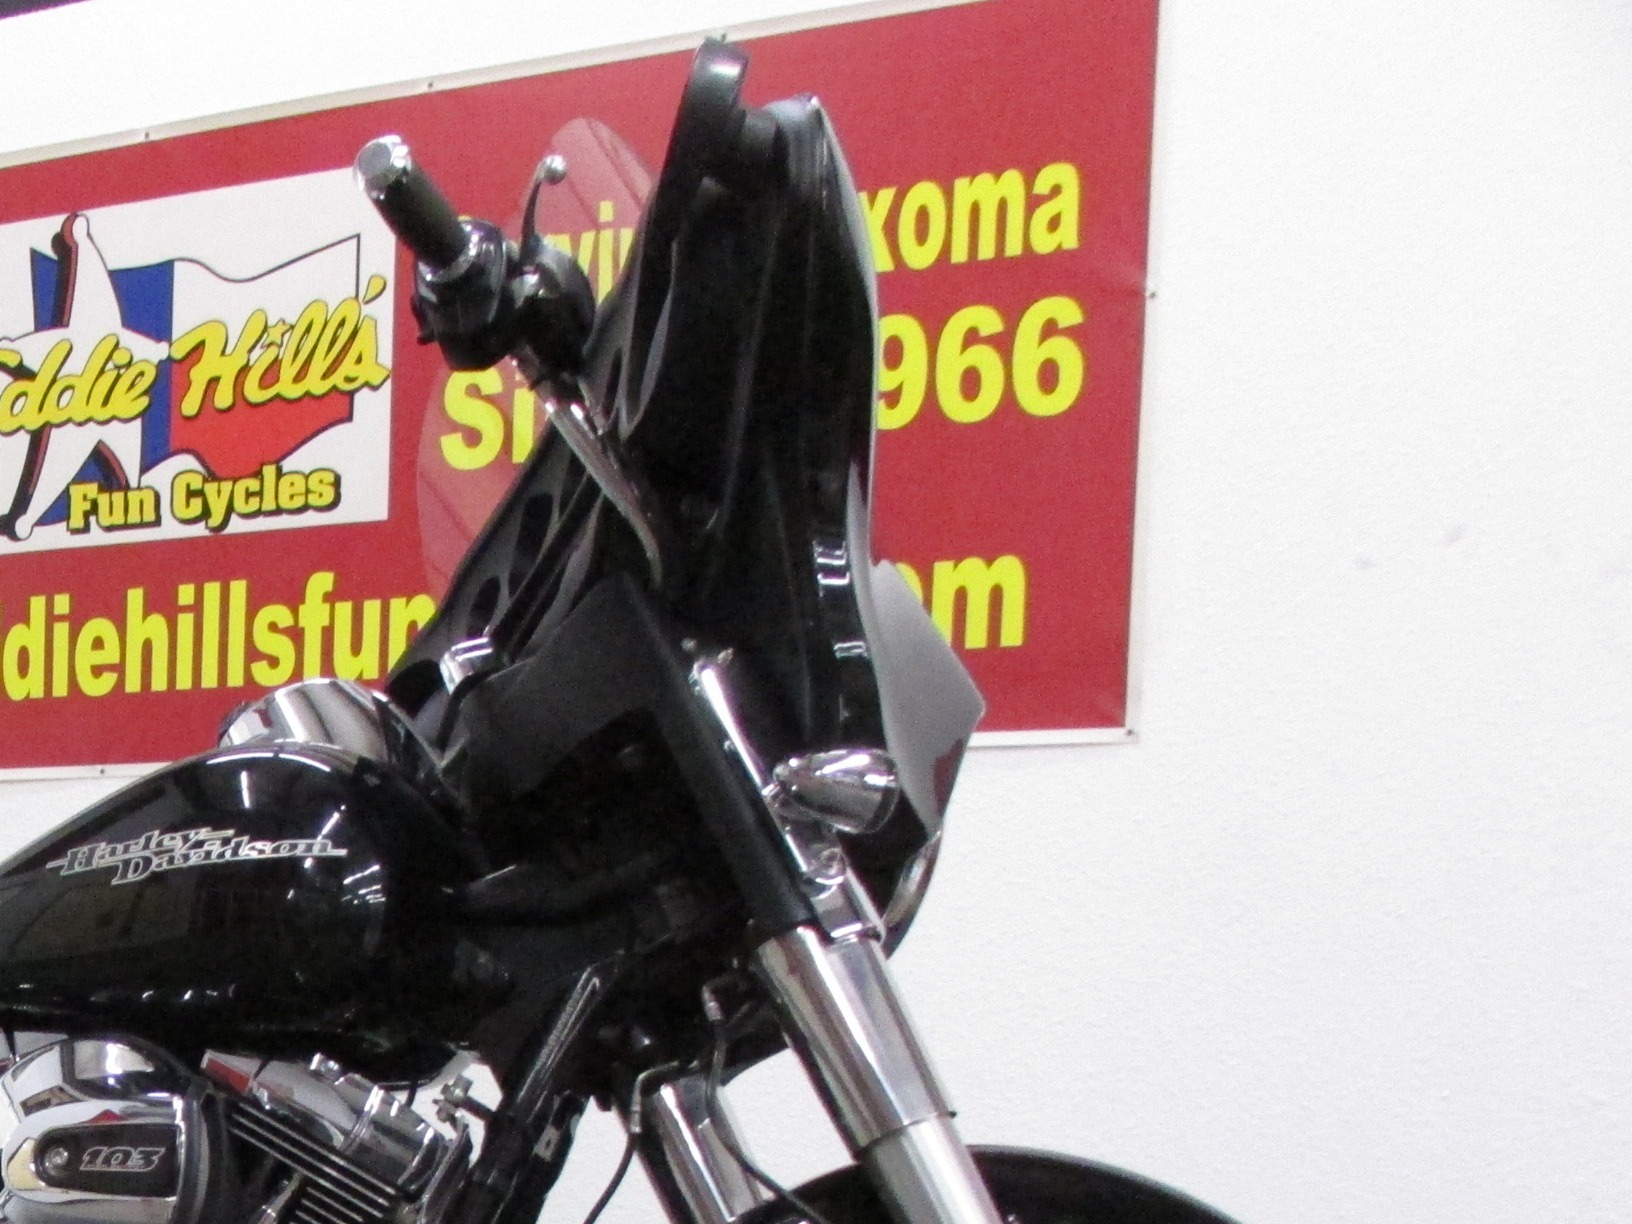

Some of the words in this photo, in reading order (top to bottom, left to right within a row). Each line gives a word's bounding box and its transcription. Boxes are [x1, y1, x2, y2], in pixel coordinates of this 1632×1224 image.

[857, 162, 1080, 273] xoma
[171, 275, 391, 418] Hill's
[874, 295, 1085, 431] 966
[67, 482, 161, 533] Fun
[171, 464, 342, 530] Cycles
[111, 835, 348, 885] Davidson
